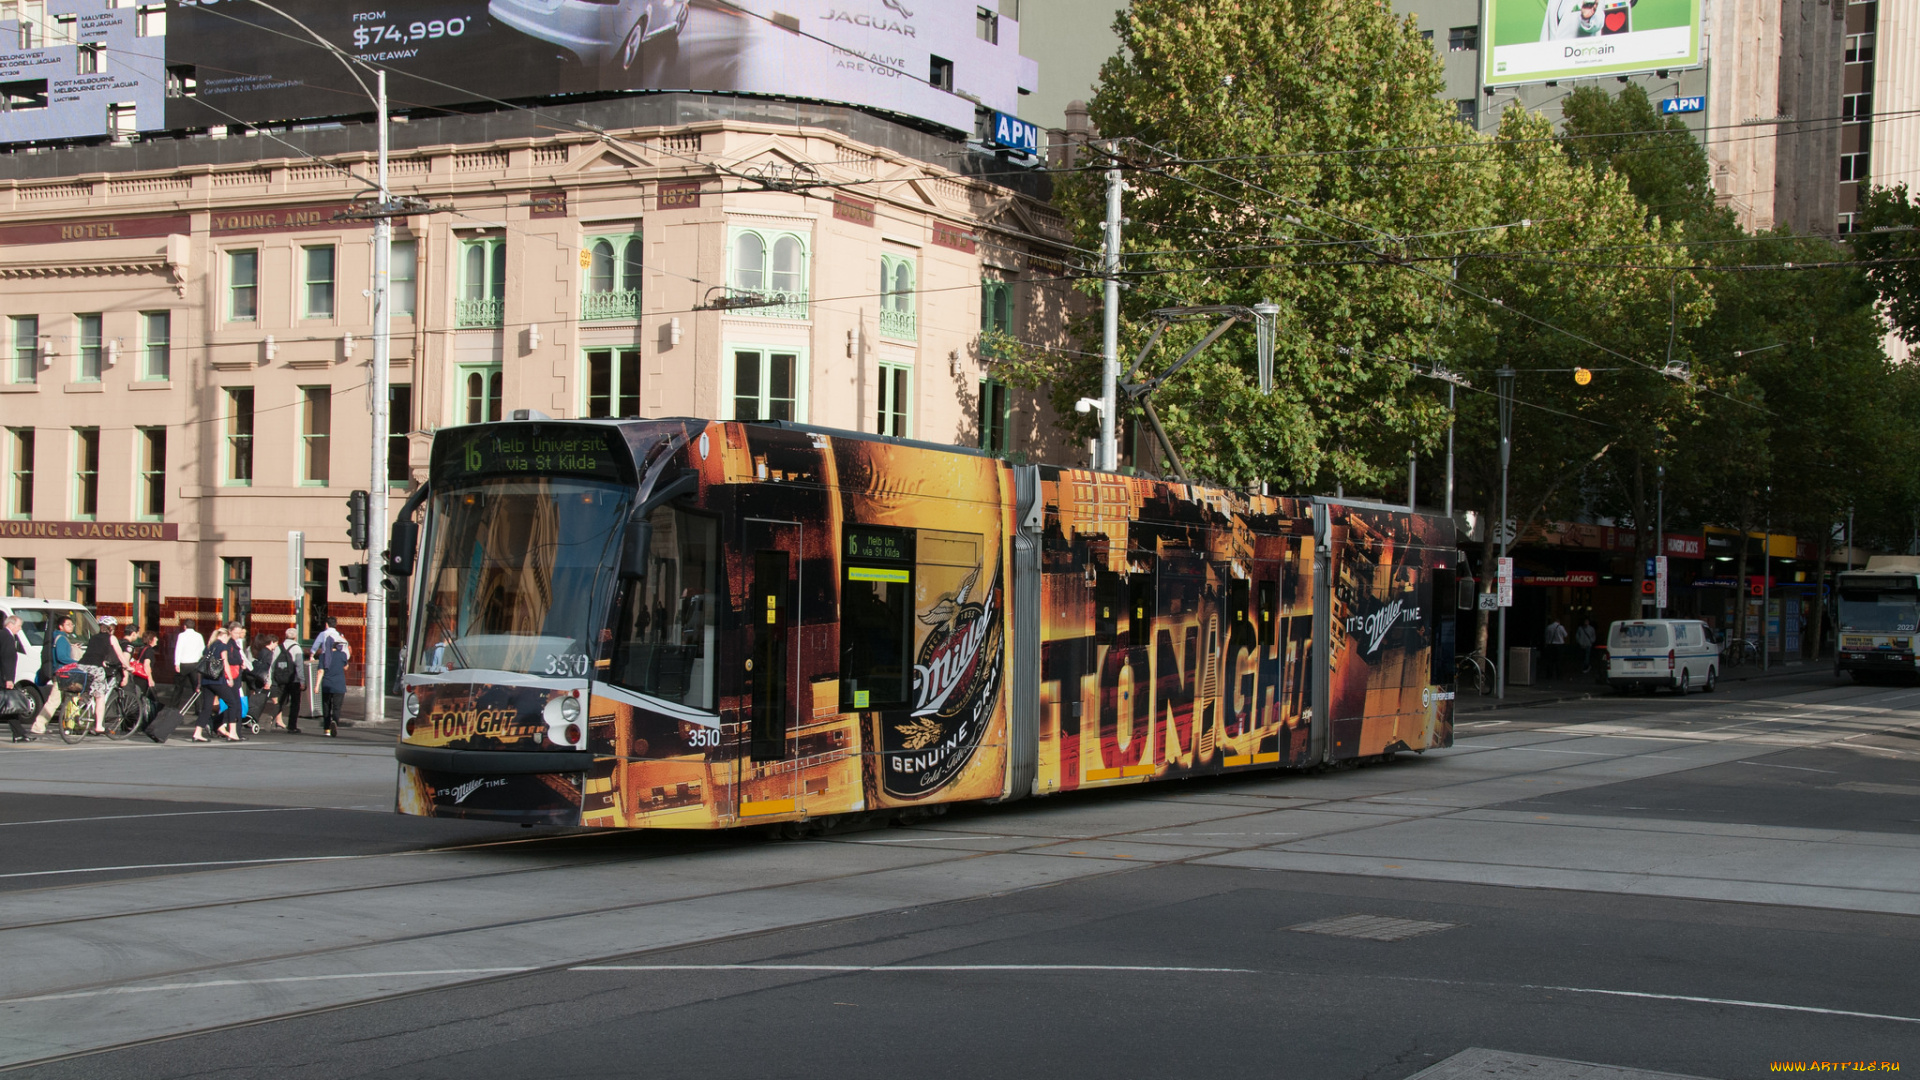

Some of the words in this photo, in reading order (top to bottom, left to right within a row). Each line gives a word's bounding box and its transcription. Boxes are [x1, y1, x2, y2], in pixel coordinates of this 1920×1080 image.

[81, 13, 114, 22] MALVERN
[96, 19, 123, 28] JAGUAR
[353, 11, 386, 22] FROM
[818, 9, 916, 39] JAGUAR
[25, 51, 45, 59] WEST
[353, 48, 419, 64] DRIVEAWAY
[832, 46, 867, 58] HOW
[870, 53, 905, 68] ALIVE
[1563, 43, 1615, 59] Domain
[35, 57, 61, 65] JAGUAR
[836, 60, 864, 72] ARE
[869, 64, 902, 80] YOU?
[54, 85, 96, 94] MELBOURNE
[96, 83, 111, 91] CITY
[112, 80, 139, 89] JAGUAR
[73, 76, 115, 85] MELBOURNE
[1667, 98, 1701, 112] APN
[997, 115, 1037, 151] APN
[662, 187, 696, 207] 1875
[215, 213, 276, 230] YOUNG
[284, 210, 321, 227] AND
[60, 221, 120, 241] HOTEL
[492, 438, 525, 453] Melb
[463, 440, 482, 471] 16
[506, 456, 528, 470] via
[535, 454, 552, 470] St
[559, 453, 597, 470] Kilda
[0, 522, 58, 537] YOUNG
[64, 526, 72, 537] &
[77, 522, 164, 539] JACKSON
[849, 534, 858, 555] 16
[868, 535, 883, 547] Melb
[884, 536, 896, 547] Uni
[1667, 538, 1686, 552] HUNGRY
[862, 545, 873, 557] via
[875, 546, 886, 557] St
[884, 546, 900, 559] Kilda
[1346, 614, 1364, 633] IT'S
[1365, 600, 1404, 655] Miller
[1402, 606, 1422, 623] TIME
[1896, 623, 1915, 631] 2023
[911, 588, 998, 717] Miller
[545, 653, 589, 677] 3510
[1040, 613, 1313, 791] TONIGHT
[431, 709, 518, 739] TONIGHT
[688, 729, 720, 748] 3510
[892, 721, 968, 773] GENUINE
[437, 788, 450, 797] IT'S
[450, 778, 485, 805] Miller
